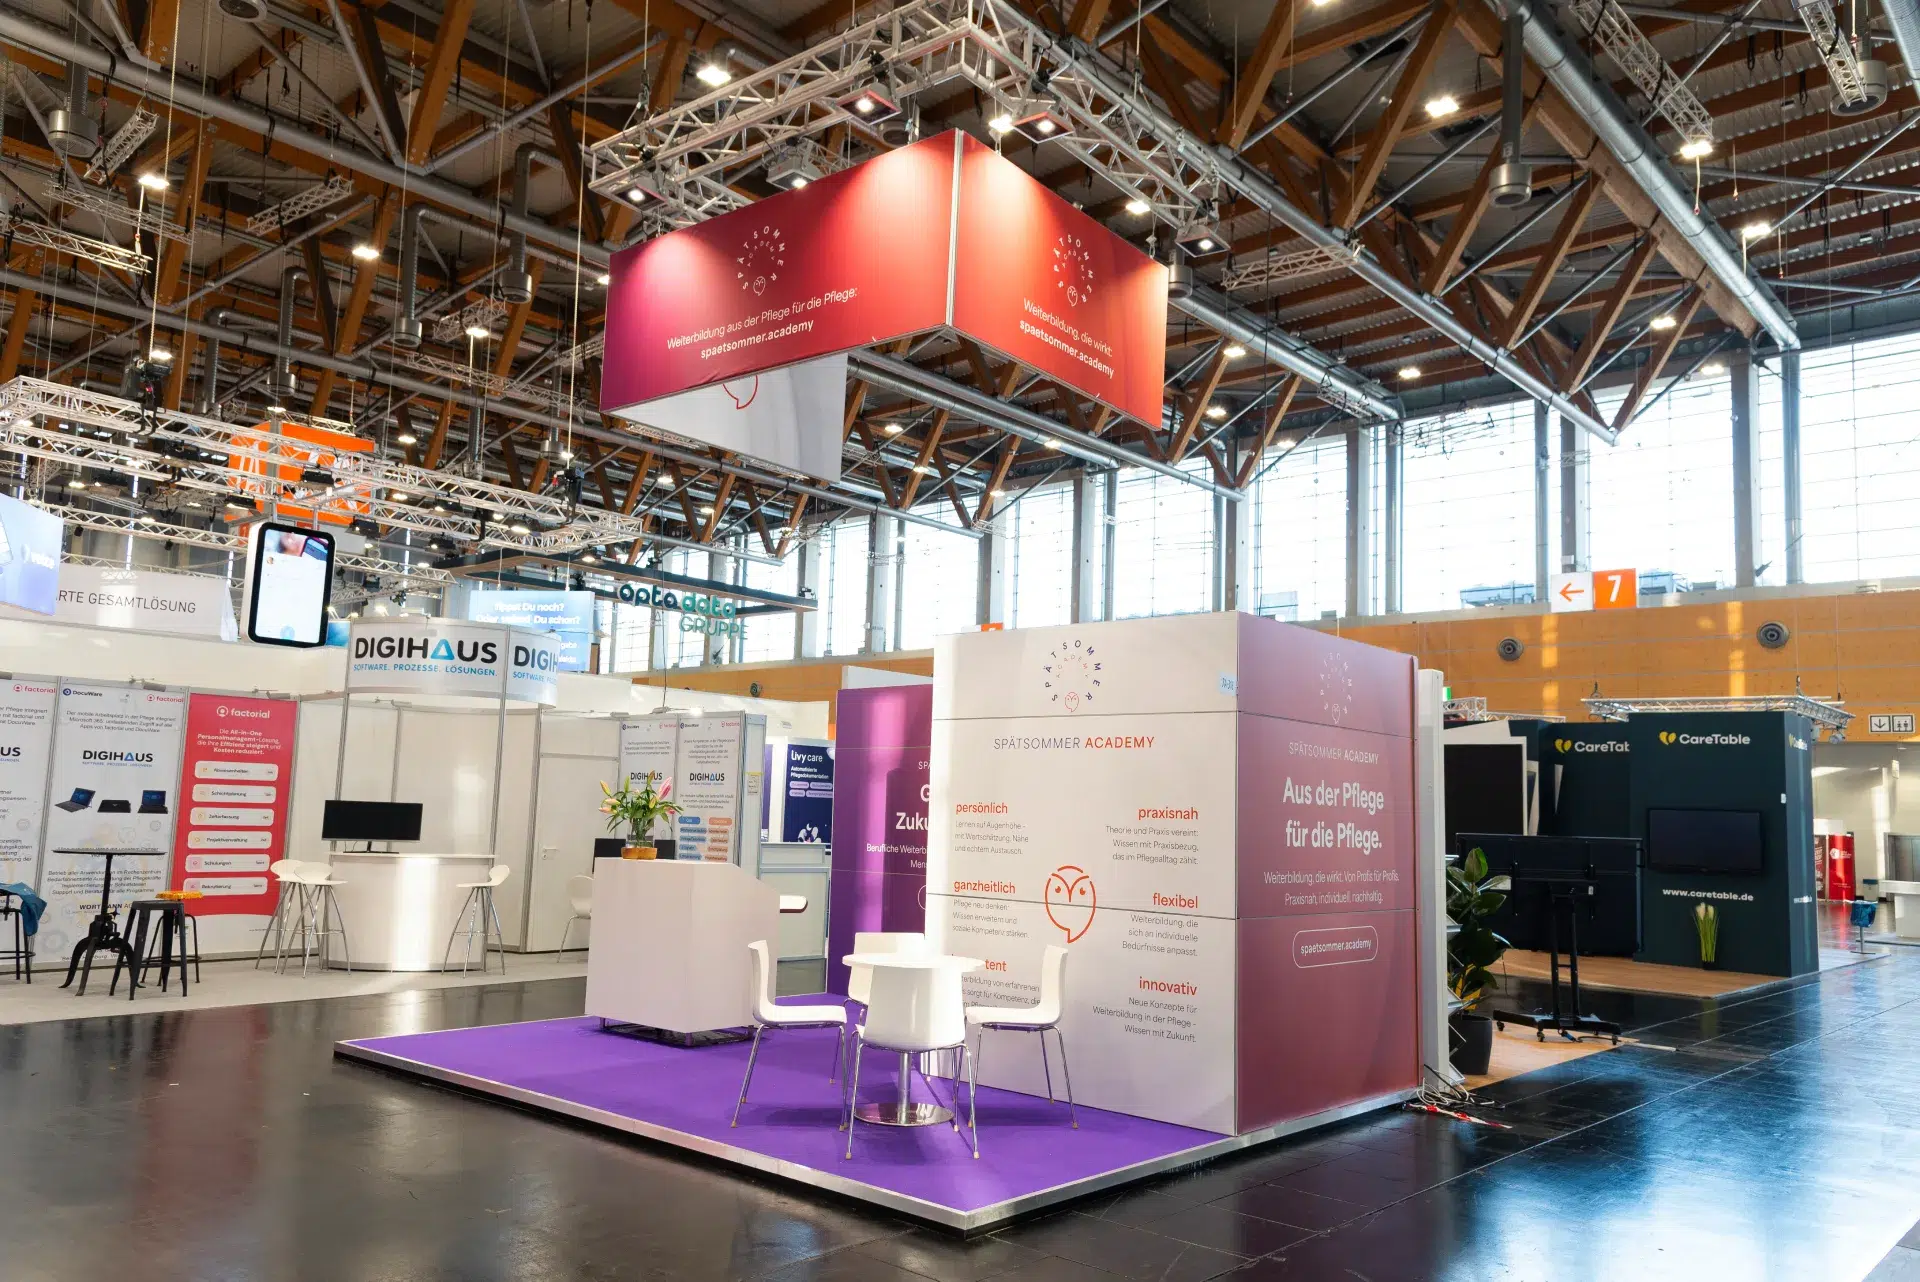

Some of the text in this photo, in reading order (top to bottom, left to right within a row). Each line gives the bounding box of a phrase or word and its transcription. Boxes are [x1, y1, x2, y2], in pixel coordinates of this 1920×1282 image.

[667, 287, 858, 350] Weiterbildung aus der Pflege für die Pflege:
[1024, 298, 1080, 340] Weiterbildung,
[1081, 331, 1093, 346] die
[701, 319, 814, 360] spaetsommer.academy
[1020, 320, 1114, 379] spaetsommer.academy
[1607, 575, 1622, 602] 7
[56, 590, 196, 614] RTE GESAMTLÖSUNG
[619, 583, 736, 618] opta data
[680, 615, 749, 640] GRUPPE
[355, 636, 498, 664] DIGIHAUS
[353, 663, 390, 672] SOFTWARE.
[445, 664, 498, 677] LÖSUNGEN.
[231, 708, 270, 719] factorial
[993, 735, 1155, 750] SPÄTSOMMER ACADEMY
[1679, 733, 1751, 745] CareTable
[82, 750, 154, 763] DIGIHAUS
[807, 754, 823, 762] care
[1289, 740, 1379, 764] SPÄTSOMMER ACADEMY
[630, 772, 663, 780] DIGIHUS
[690, 773, 725, 781] DIGIHAUS
[1283, 777, 1384, 815] Aus der Pflege
[956, 802, 1008, 815] persönlich
[1138, 806, 1198, 820] praxisnah
[956, 820, 975, 828] Lernen
[986, 821, 1021, 830] Augenhöhe
[1106, 825, 1199, 836] Theorie und Praxis vereint:
[1012, 834, 1029, 842] Nähe
[1286, 819, 1382, 855] für die Pflege.
[866, 843, 899, 853] Berufliche
[967, 845, 989, 853] echtem
[1113, 839, 1138, 848] Wissen
[1153, 841, 1199, 852] Praxisbezug,
[1112, 853, 1124, 861] das
[1136, 853, 1178, 865] Pflegealltag
[1179, 856, 1199, 865] zählt.
[1264, 871, 1314, 886] Weiterbildung,
[1315, 870, 1326, 883] die
[1344, 871, 1356, 882] Von
[1356, 870, 1373, 882] Profis
[1373, 870, 1382, 882] für
[1382, 869, 1399, 882] Profis.
[954, 880, 1016, 894] ganzheitlich
[1153, 892, 1198, 908] flexibel
[1285, 892, 1317, 906] Praxisnah,
[1352, 890, 1384, 904] nachhaltig.
[1662, 888, 1754, 902] www.caretable.de
[79, 903, 123, 911] WORTANN
[953, 899, 971, 908] Pflege
[1131, 914, 1184, 928] Weiterbildung,
[1128, 928, 1143, 936] sich
[1155, 930, 1198, 942] individuelle
[1122, 941, 1198, 957] Bedürfnisse anpasst.
[1300, 939, 1372, 957] spaetsommer.academy
[1005, 981, 1040, 992] erfahrenen
[1139, 976, 1197, 995] innovativ
[967, 990, 982, 998] sorgt
[984, 990, 992, 998] für
[1031, 997, 1041, 1005] die
[1129, 997, 1198, 1013] Neue Konzepte für
[1092, 1006, 1192, 1028] Weiterbildung in der Pflege
[1124, 1024, 1197, 1042] Wissen mit Zukunft.
